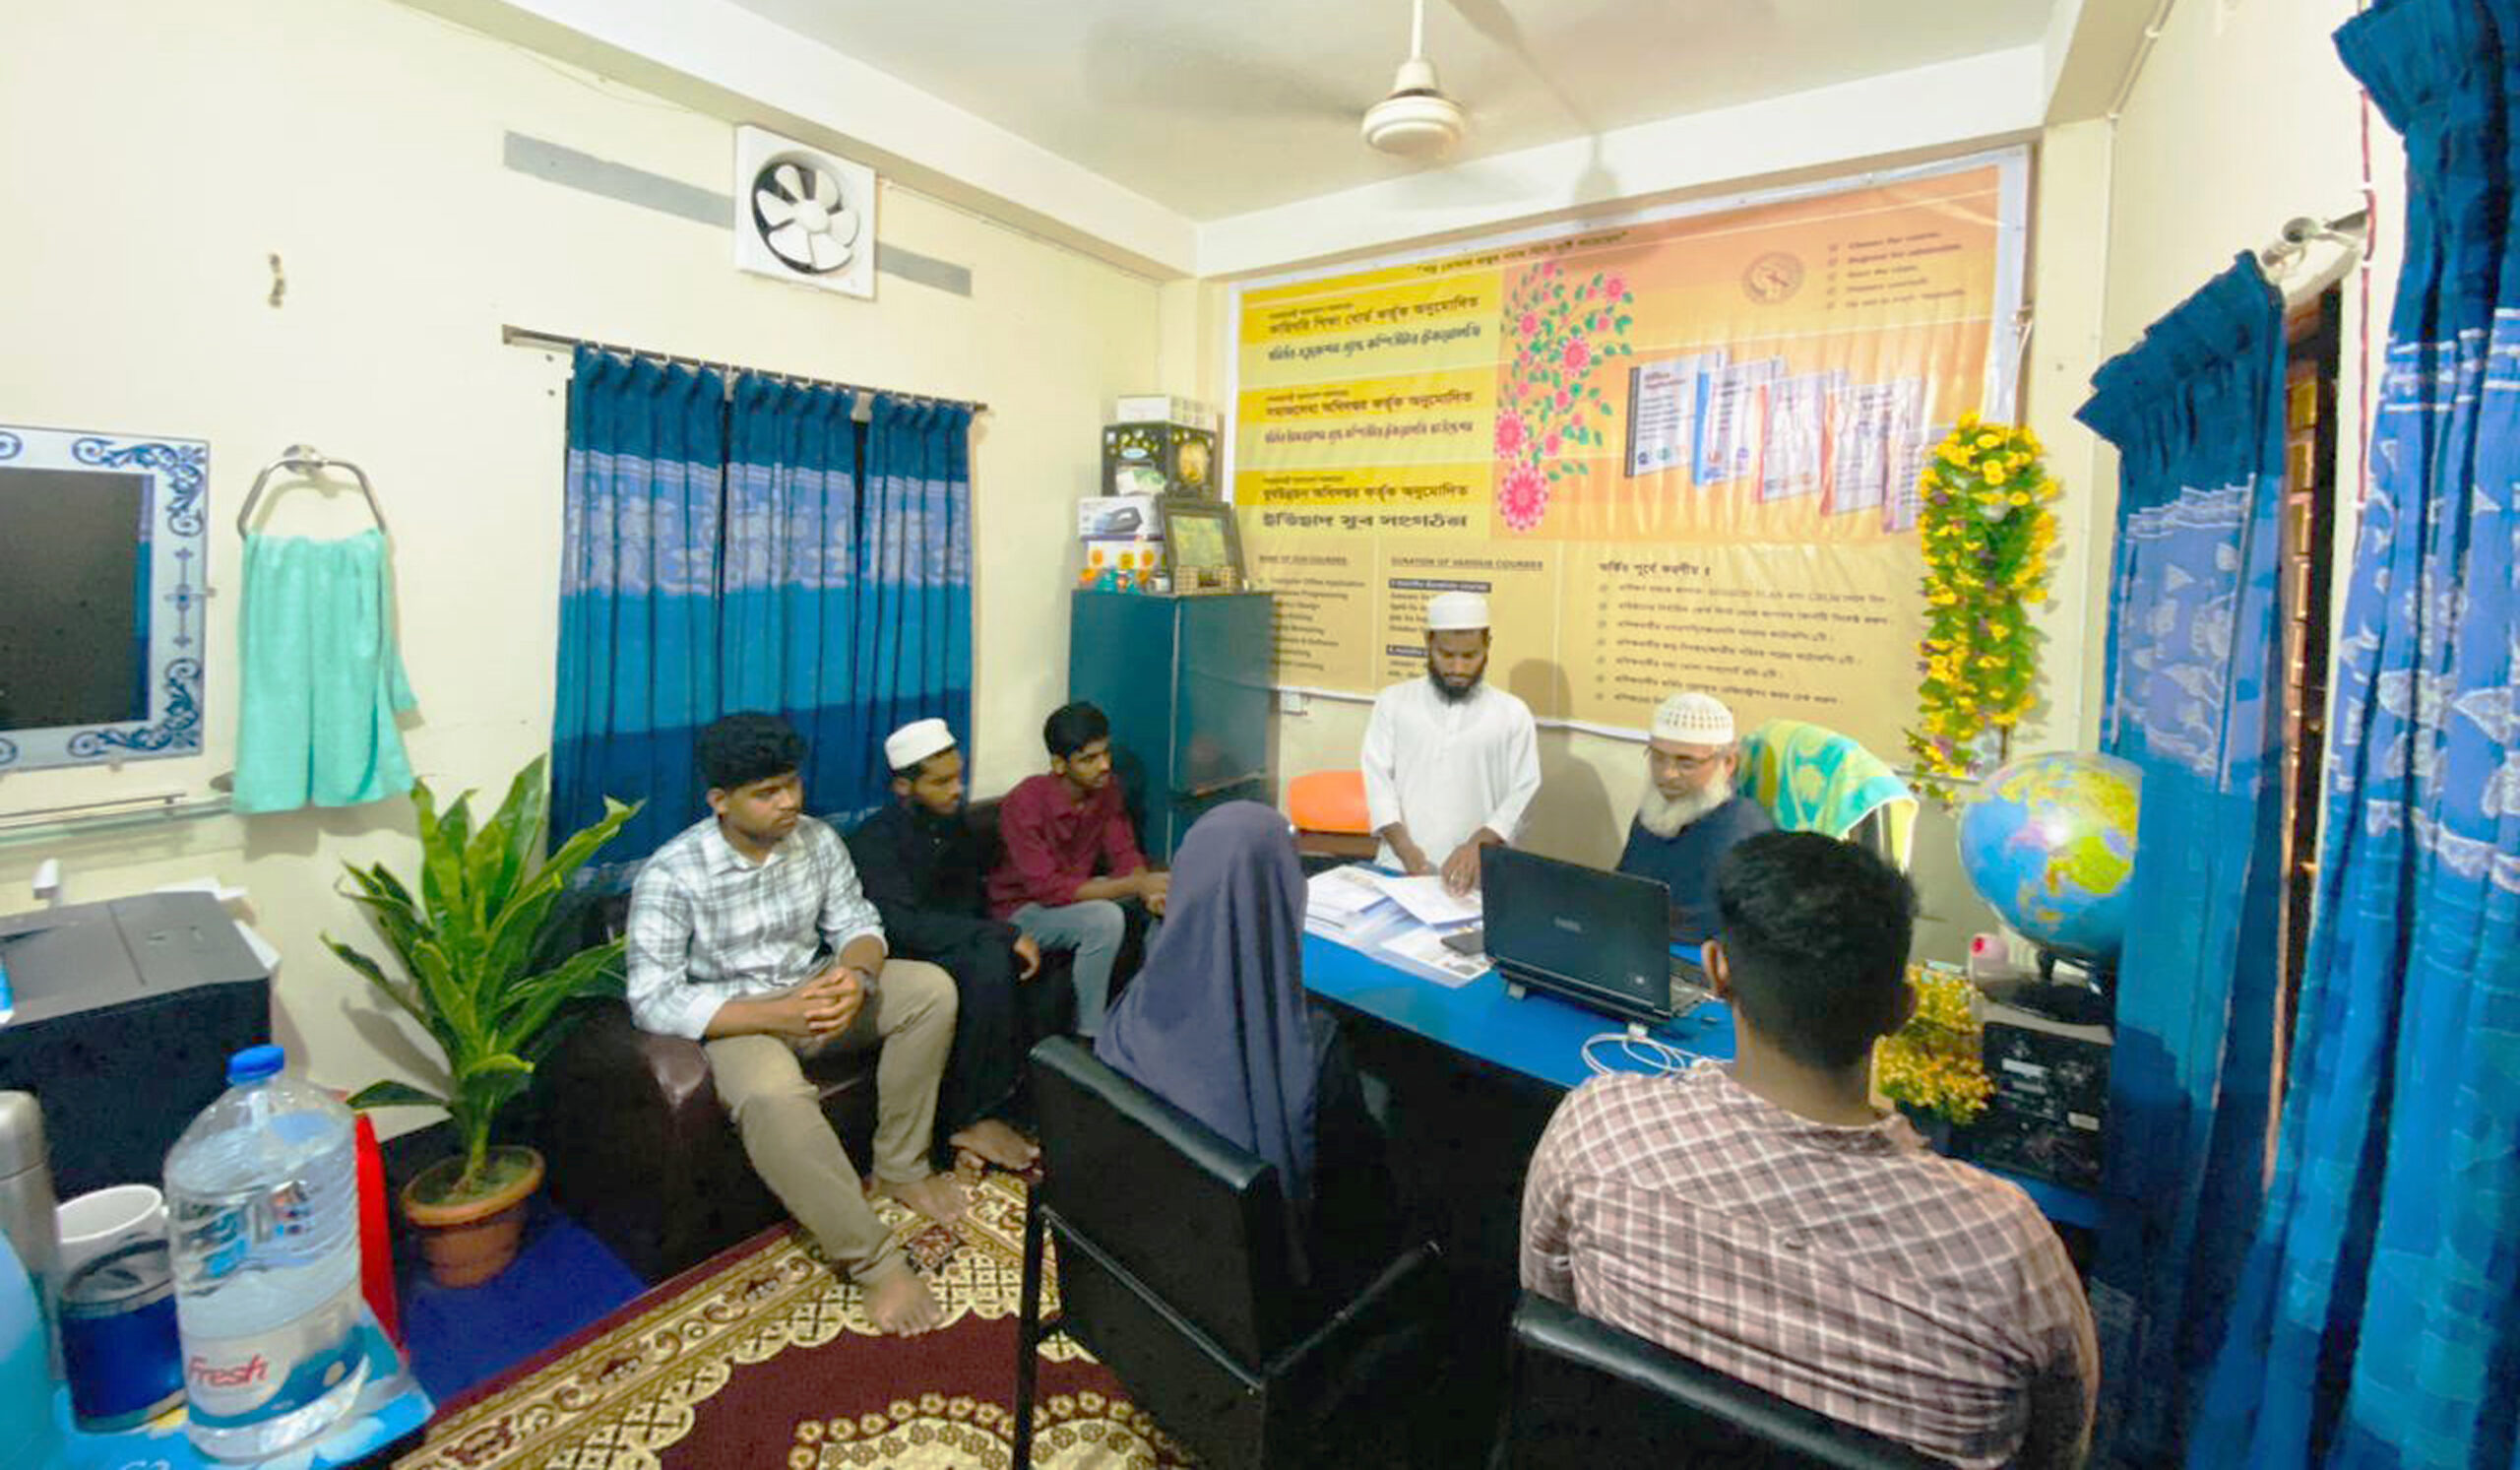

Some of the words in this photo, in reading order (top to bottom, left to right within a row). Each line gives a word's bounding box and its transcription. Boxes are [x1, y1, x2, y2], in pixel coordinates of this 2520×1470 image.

[1415, 294, 1480, 316] অনুমোদিত
[1408, 389, 1474, 409] অনুমোদিত
[1400, 481, 1469, 500] অনুমোদিত
[1379, 512, 1468, 529] সংগঠন
[188, 1353, 269, 1389] Fresh
